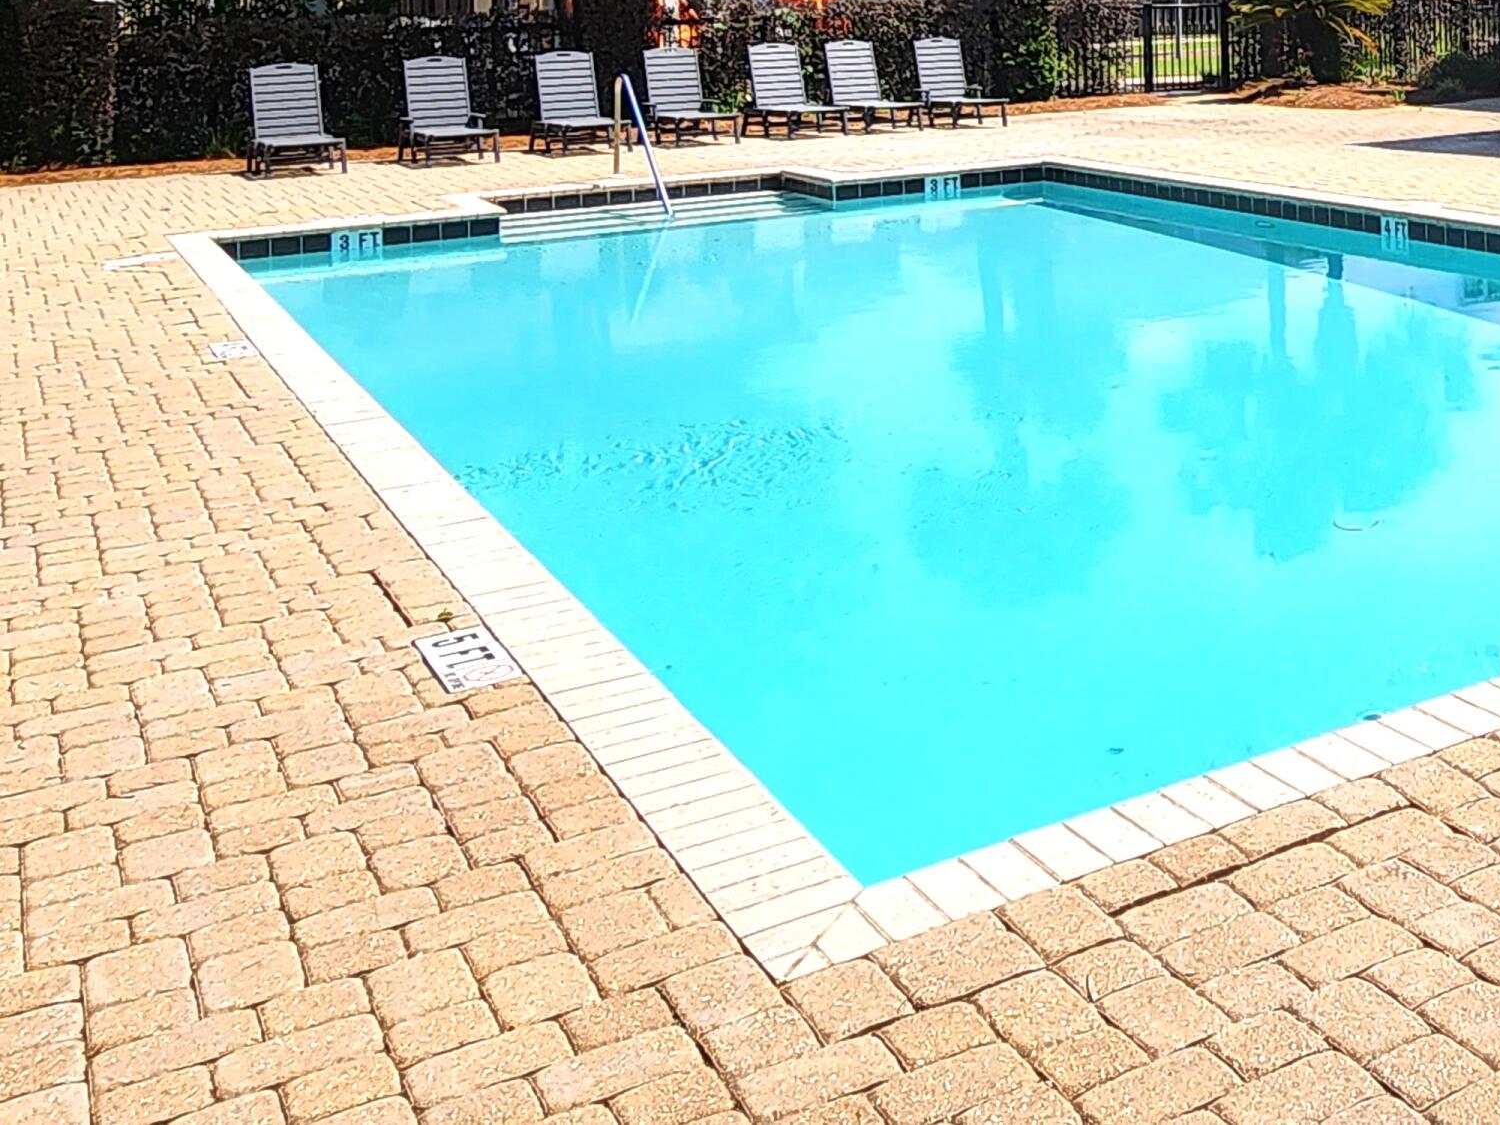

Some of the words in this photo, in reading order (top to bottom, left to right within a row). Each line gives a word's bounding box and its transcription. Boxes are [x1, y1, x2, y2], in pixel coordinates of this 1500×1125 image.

[930, 178, 938, 192] 3
[1385, 219, 1391, 236] 4
[339, 234, 350, 250] 3
[431, 632, 480, 648] 5
